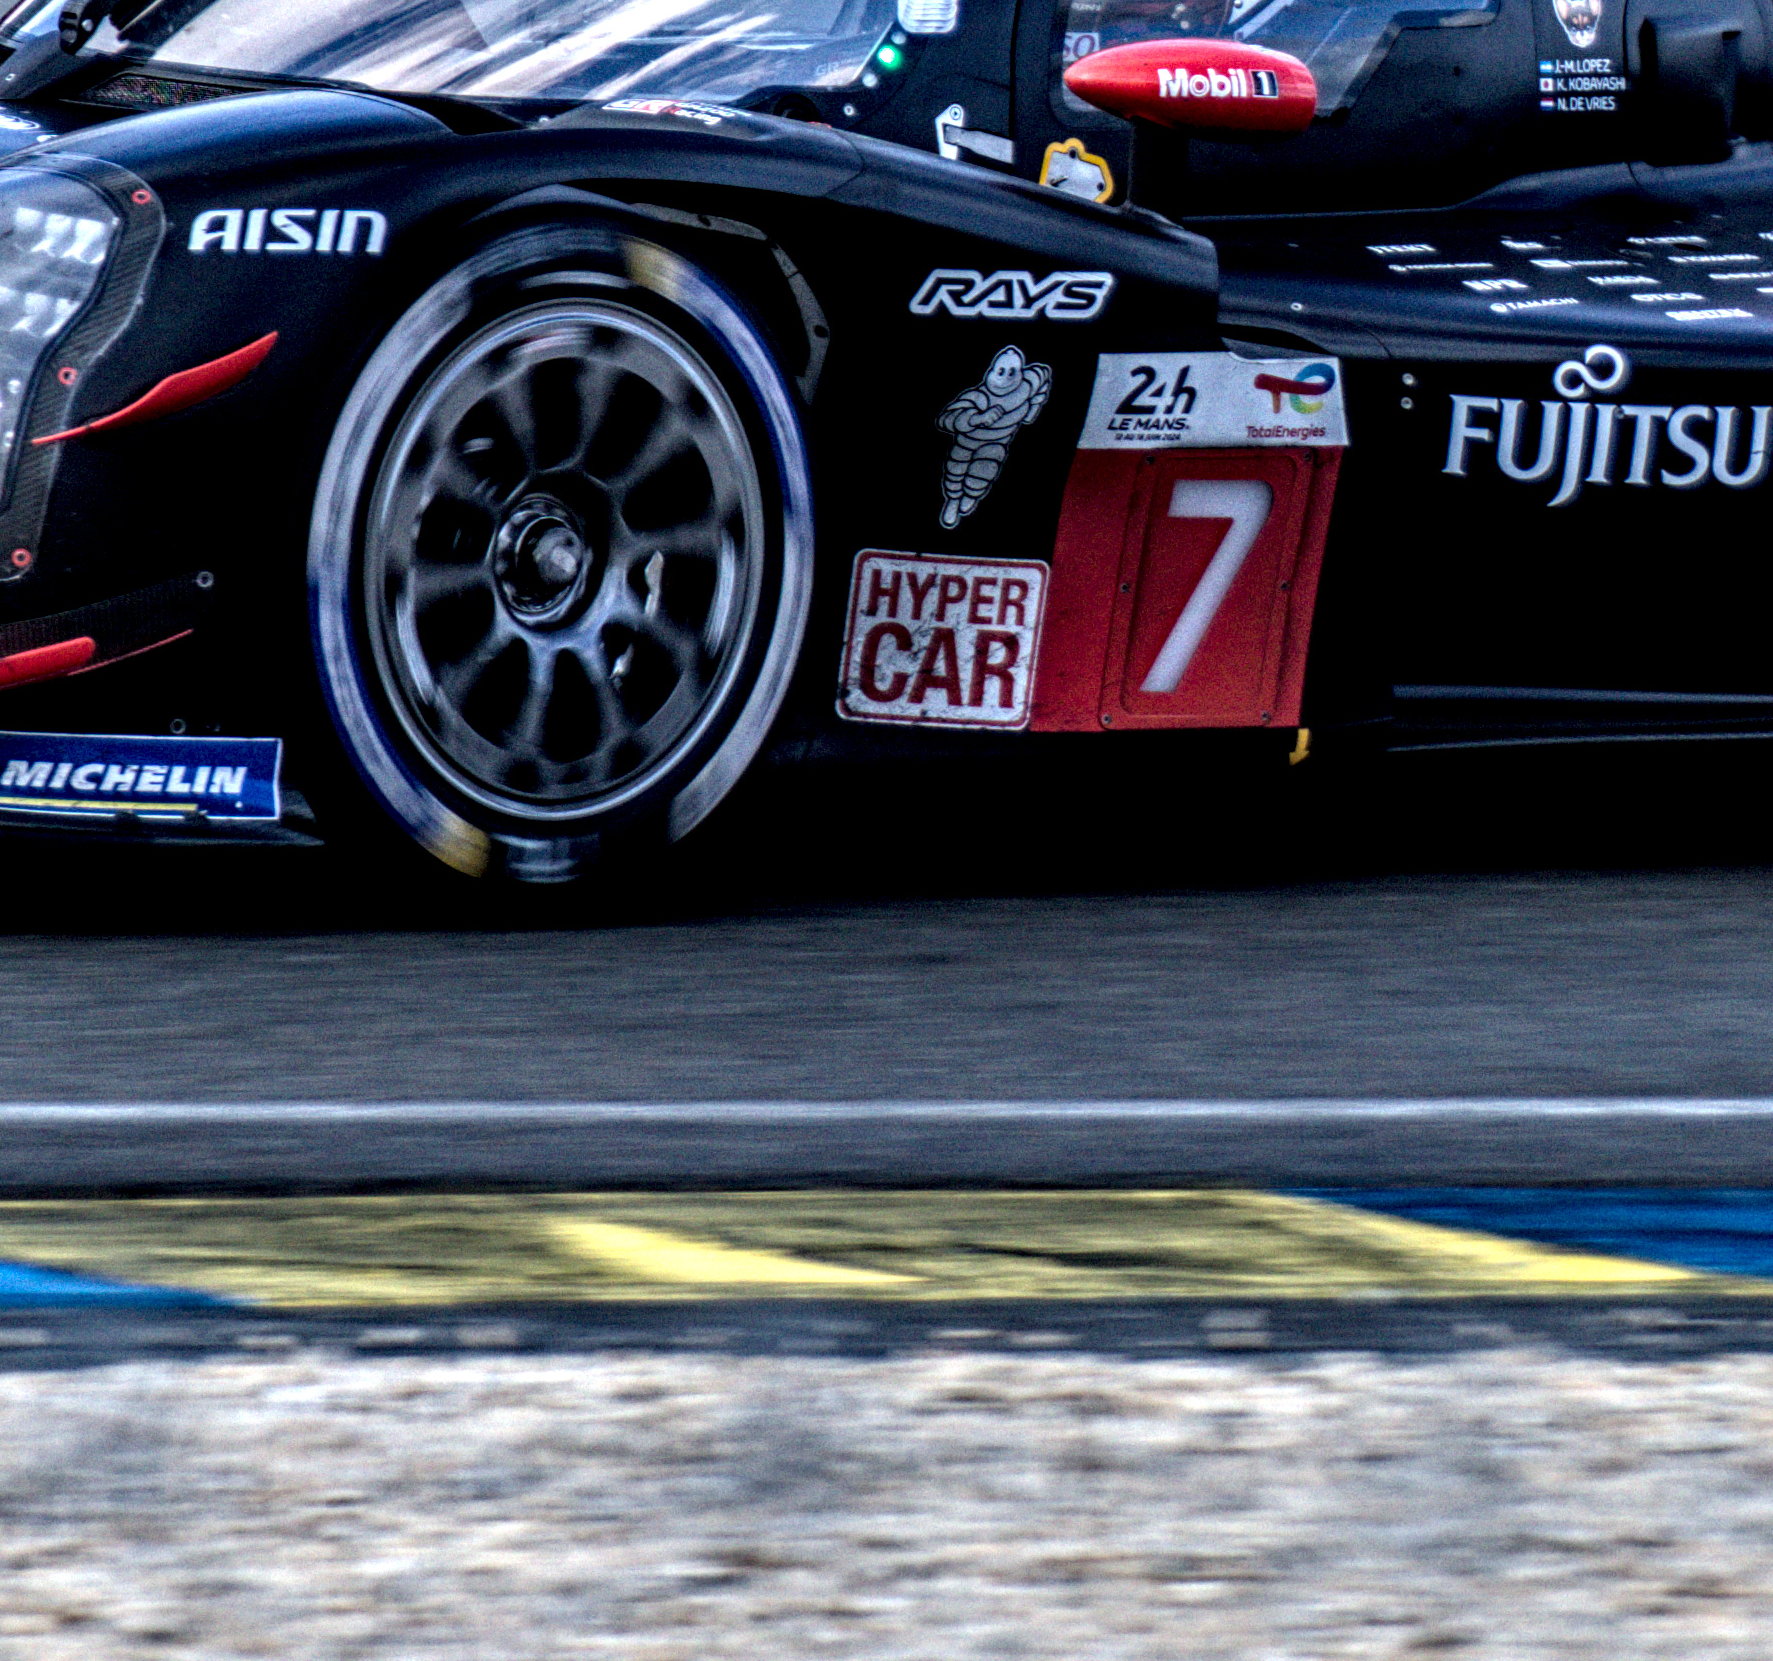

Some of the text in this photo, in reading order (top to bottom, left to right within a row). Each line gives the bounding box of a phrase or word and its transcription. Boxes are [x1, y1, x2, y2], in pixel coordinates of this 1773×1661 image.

[1158, 68, 1247, 98] Mobil
[1569, 76, 1626, 91] KOBAYASHI
[1577, 59, 1612, 73] LOPEZ
[1585, 96, 1616, 111] VRIES
[188, 208, 389, 255] AISIN
[913, 271, 1112, 317] RAYS
[1115, 365, 1197, 415] 24h
[1107, 417, 1132, 430] LE
[1246, 425, 1326, 441] TotalEnergies
[866, 567, 1030, 627] HYPER
[1140, 479, 1275, 694] 7
[857, 620, 1022, 710] CAR
[0, 760, 248, 795] MICHELIN
